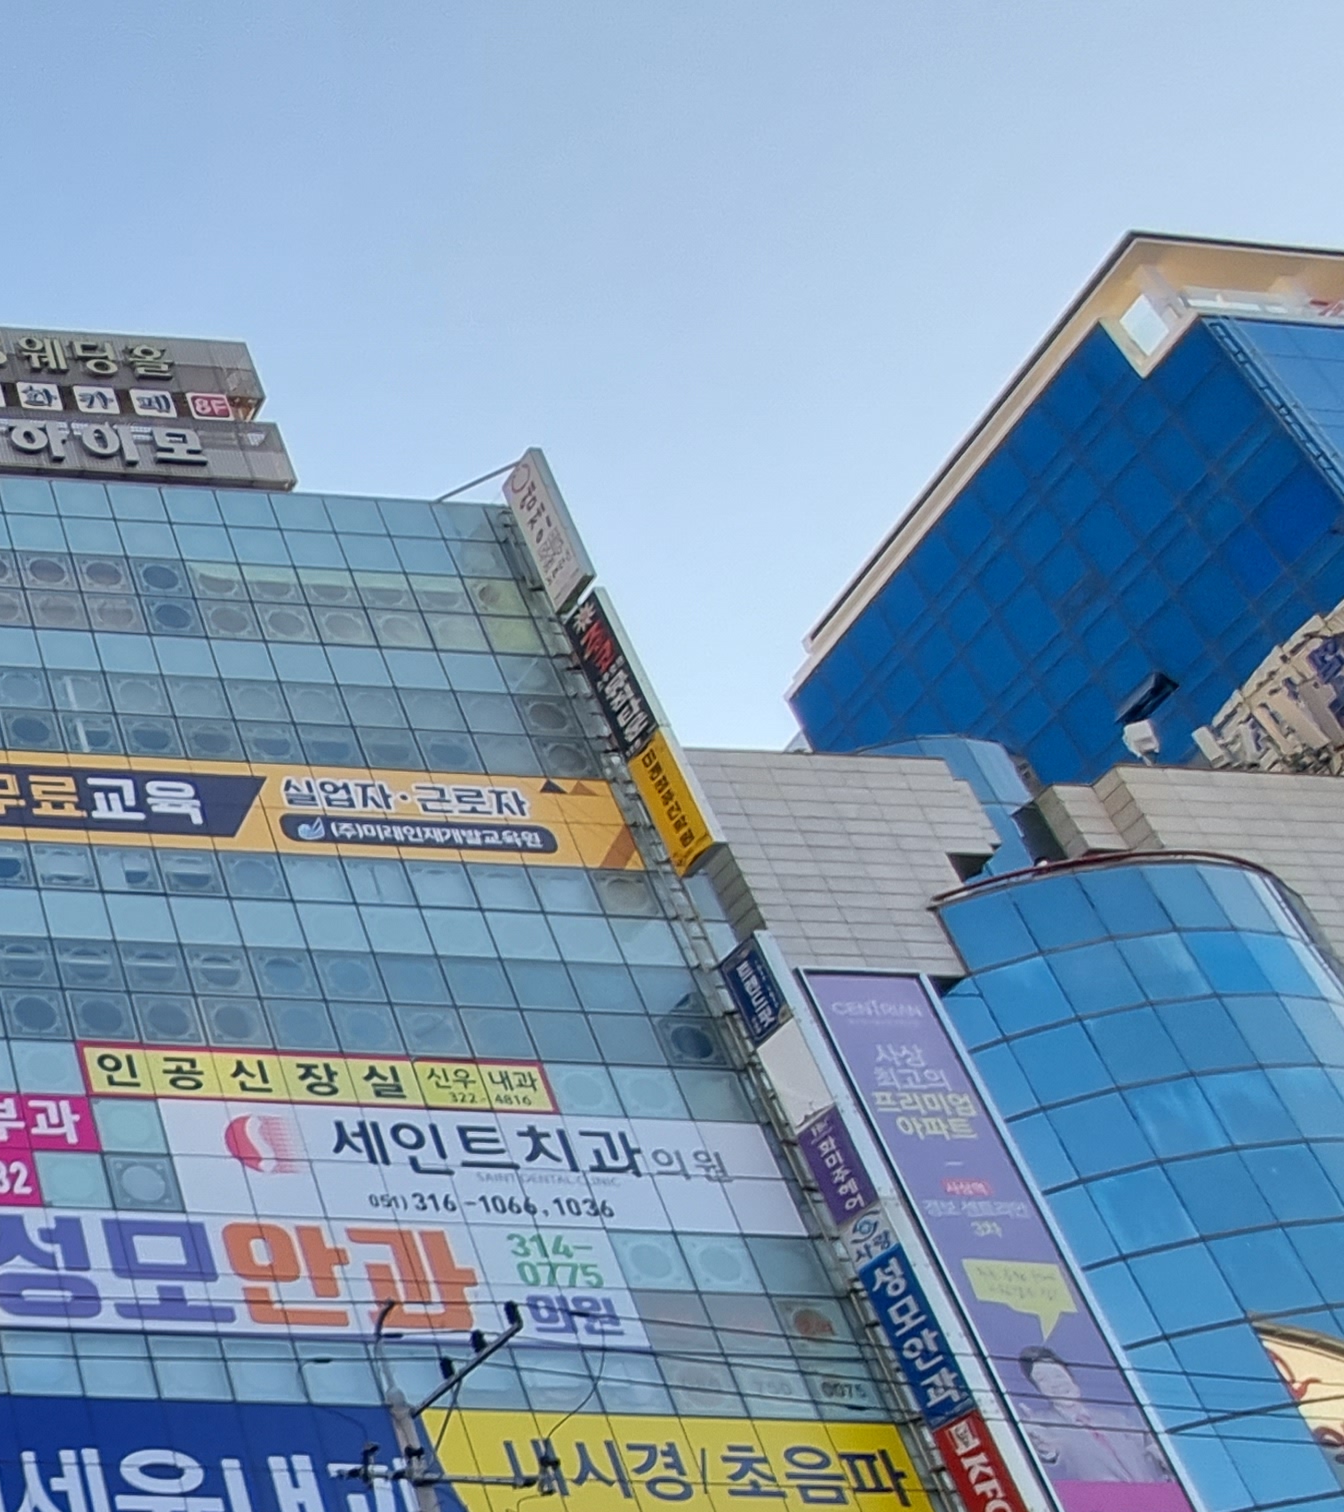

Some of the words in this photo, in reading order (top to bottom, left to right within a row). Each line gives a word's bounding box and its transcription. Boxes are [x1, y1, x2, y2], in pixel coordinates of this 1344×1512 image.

[15, 334, 177, 381] 웨딩홀
[8, 420, 209, 466] 하이모
[872, 1090, 978, 1117] 프리미엄
[896, 1112, 979, 1140] 아파트
[515, 1261, 604, 1290] 0775
[525, 1294, 627, 1336] 의원
[871, 1265, 964, 1412] 성모안과
